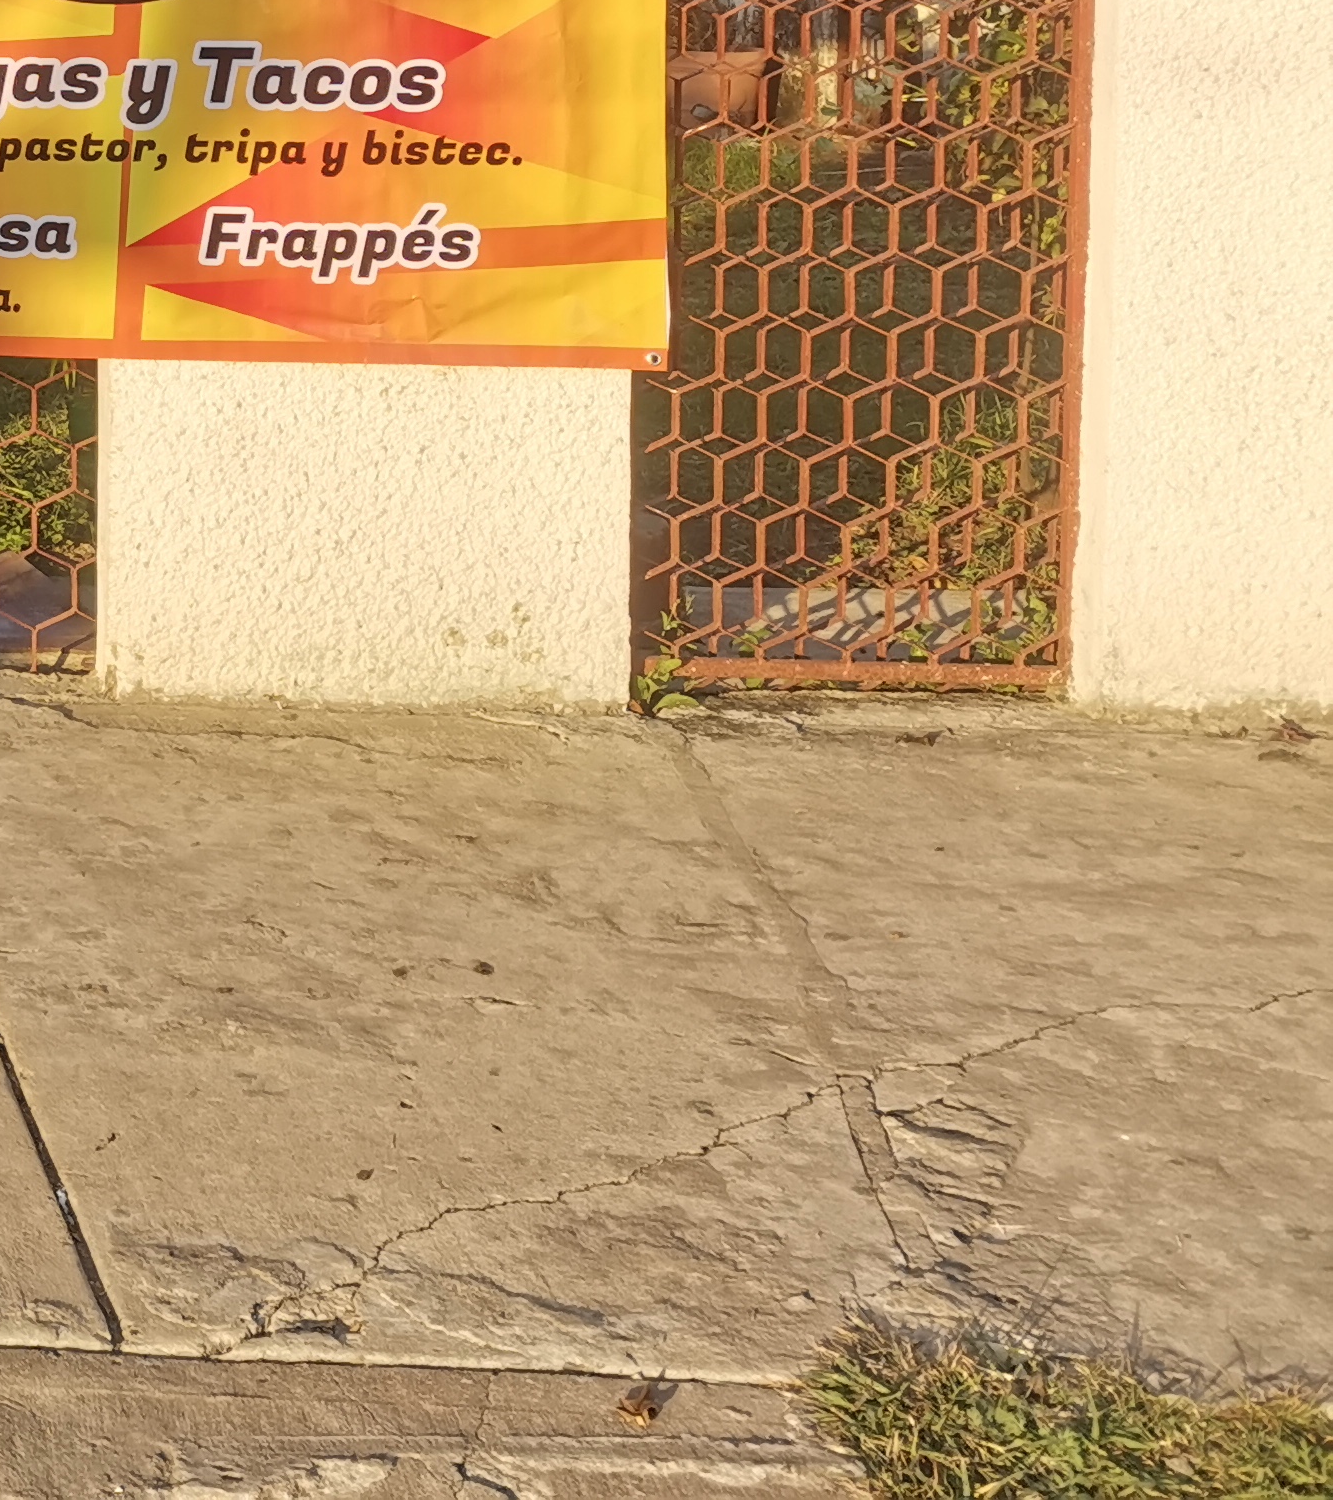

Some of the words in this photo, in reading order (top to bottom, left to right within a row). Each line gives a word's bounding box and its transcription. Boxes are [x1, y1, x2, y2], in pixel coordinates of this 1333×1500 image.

[123, 61, 174, 128] y
[196, 44, 442, 109] Tacos
[184, 128, 308, 176] tripa
[320, 140, 349, 177] y
[361, 129, 524, 167] bistec.
[201, 206, 478, 281] Frappés
